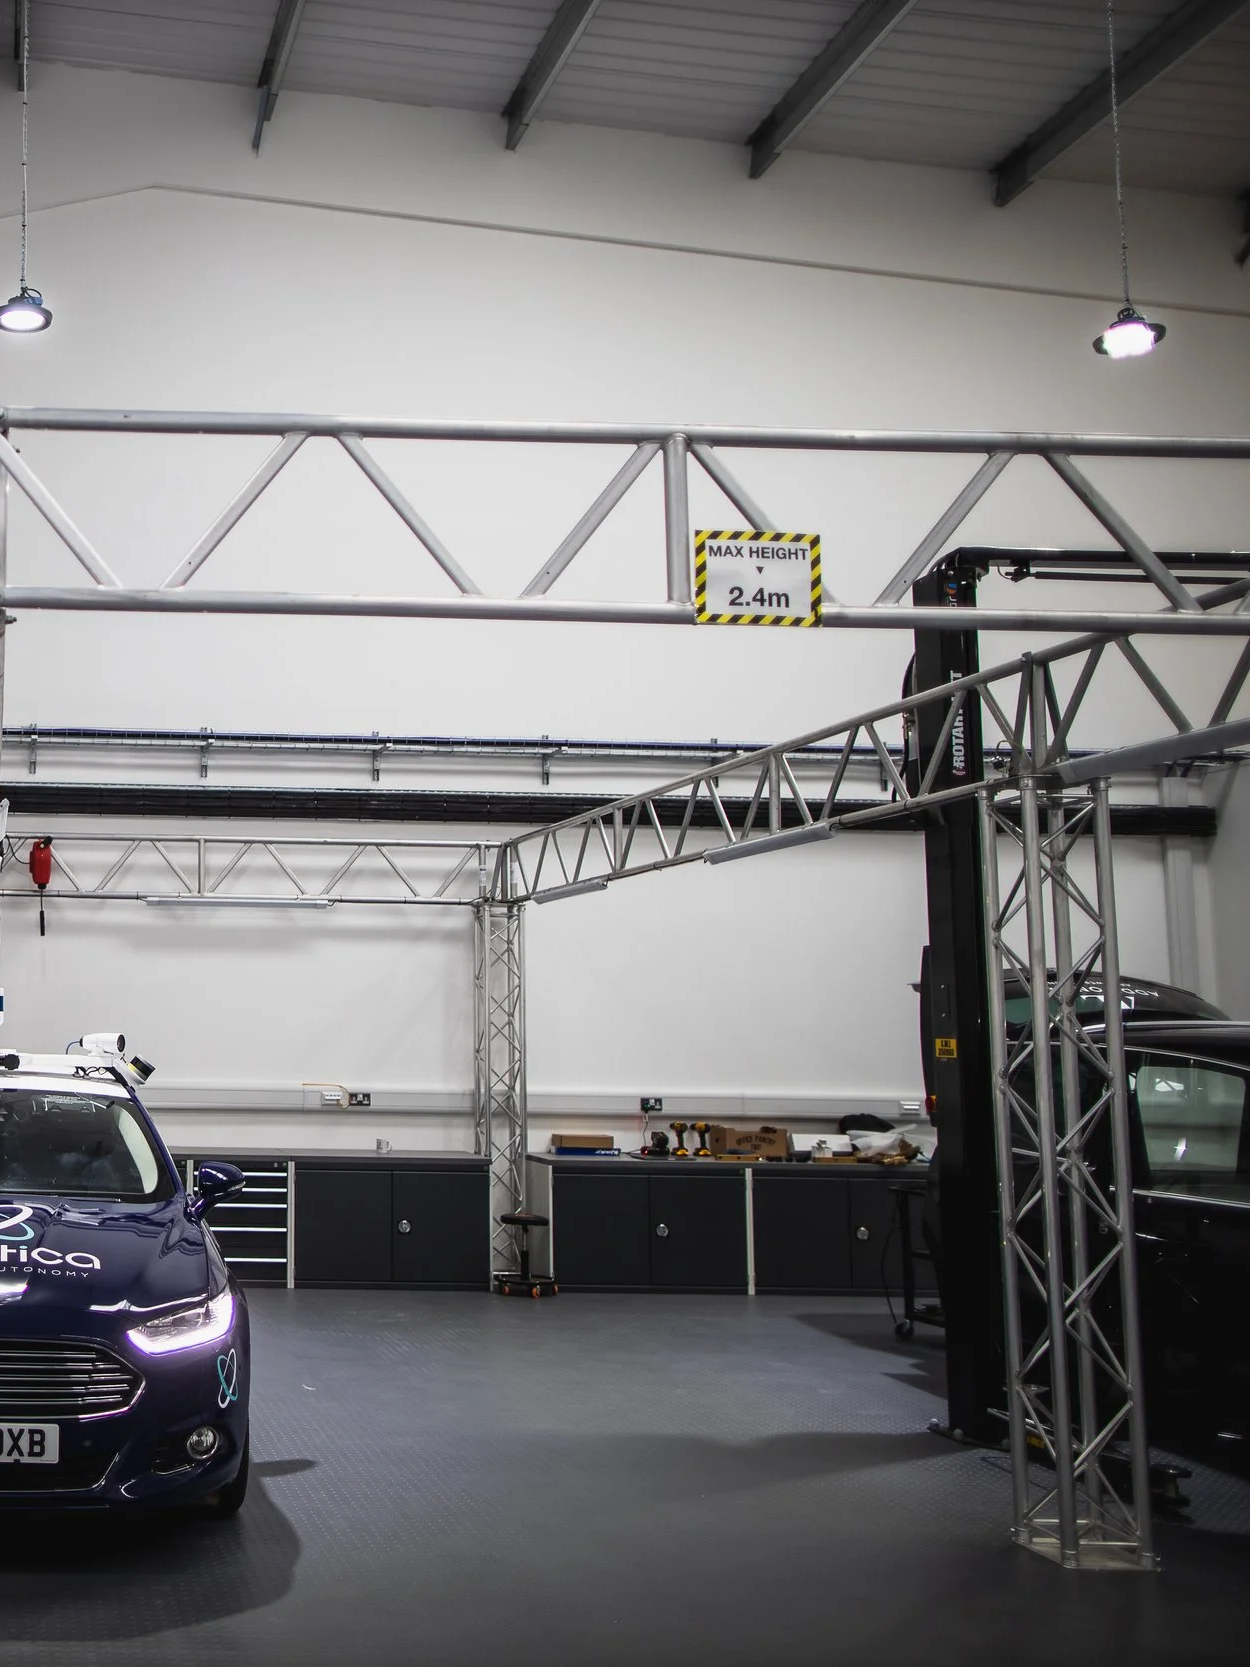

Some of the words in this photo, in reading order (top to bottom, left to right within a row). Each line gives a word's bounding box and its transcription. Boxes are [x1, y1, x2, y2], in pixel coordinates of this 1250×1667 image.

[708, 545, 744, 558] MAX
[749, 546, 809, 561] HEIGHT
[728, 586, 790, 608] 2.4m
